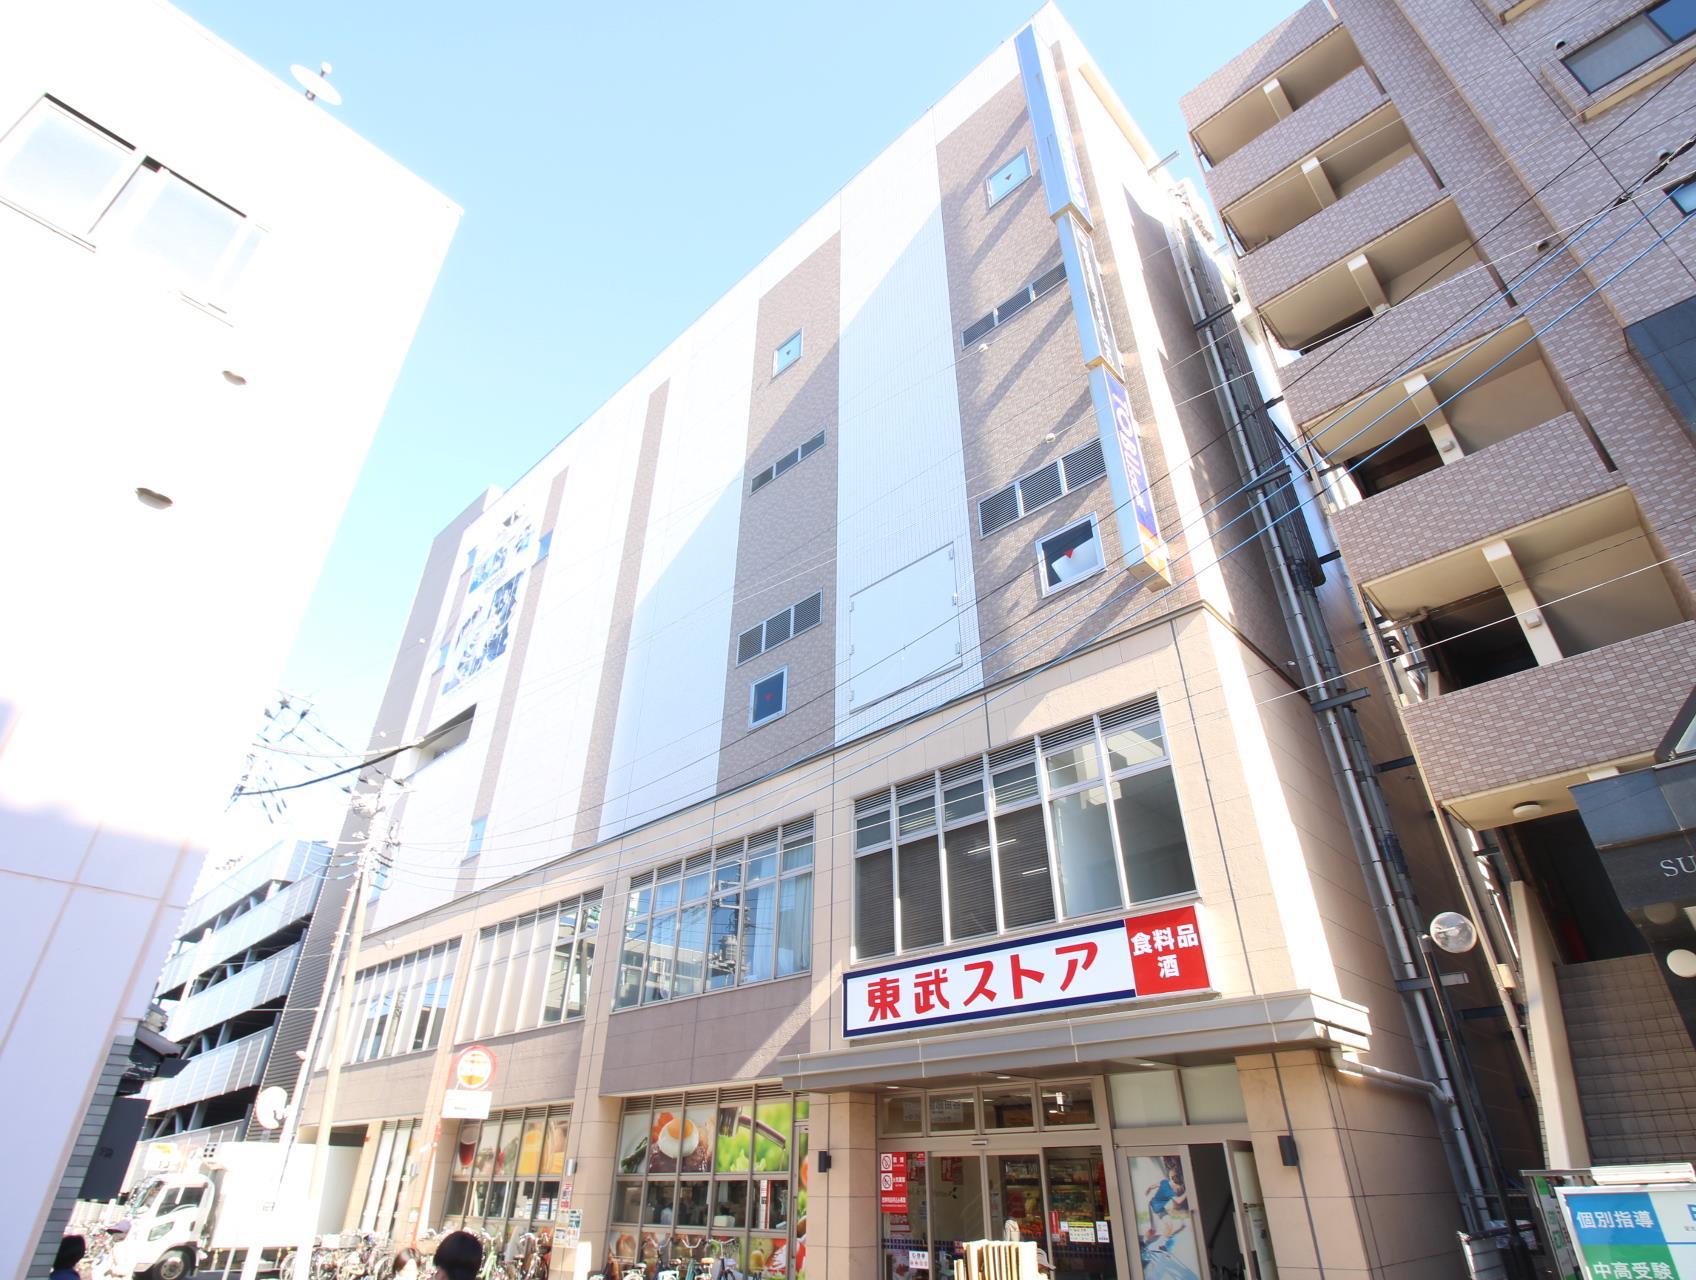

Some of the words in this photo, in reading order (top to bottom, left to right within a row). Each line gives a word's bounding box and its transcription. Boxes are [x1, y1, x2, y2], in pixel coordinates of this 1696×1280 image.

[1131, 924, 1199, 956] 食料品
[1157, 955, 1180, 979] 酒
[867, 941, 1098, 1021] 東武ストア
[1577, 1210, 1654, 1229] 個別指導
[1592, 1262, 1674, 1280] 中高受験
